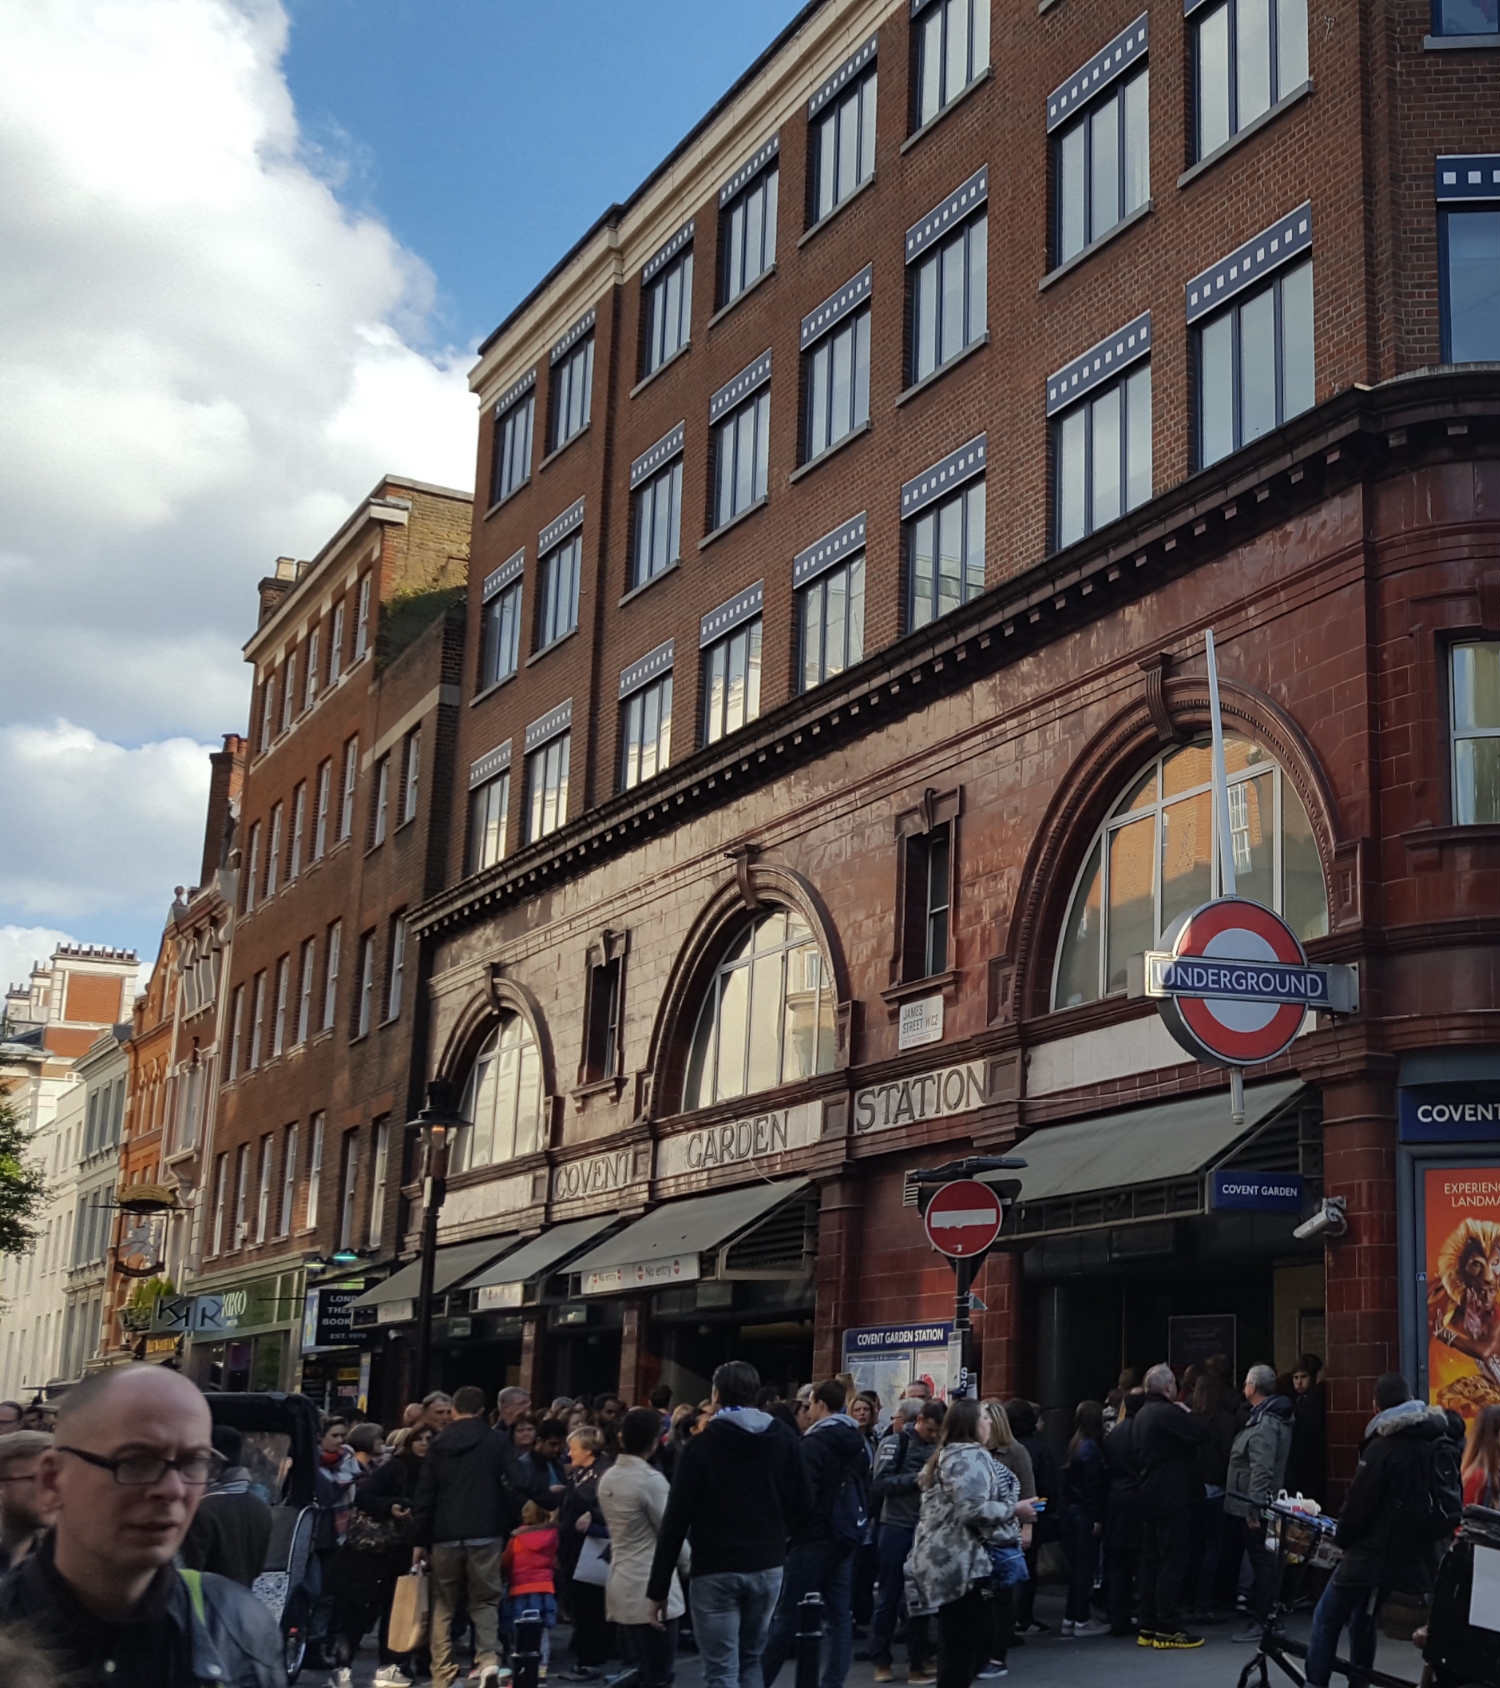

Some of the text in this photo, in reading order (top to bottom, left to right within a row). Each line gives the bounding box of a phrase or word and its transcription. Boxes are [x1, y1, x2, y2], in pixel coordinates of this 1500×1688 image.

[1156, 962, 1323, 997] UNDERGROUND
[903, 1004, 924, 1021] JAMES
[902, 1014, 939, 1034] STREET WC2
[856, 1060, 988, 1131] STATION
[687, 1110, 790, 1169] GARDEN
[555, 1150, 632, 1200] COVENT
[1222, 1184, 1298, 1197] COVENT GARDEN
[646, 1264, 671, 1278] No entry
[221, 1290, 247, 1318] KIKO
[330, 1295, 359, 1303] LOND
[857, 1328, 944, 1346] COVENT GARDEN STATION
